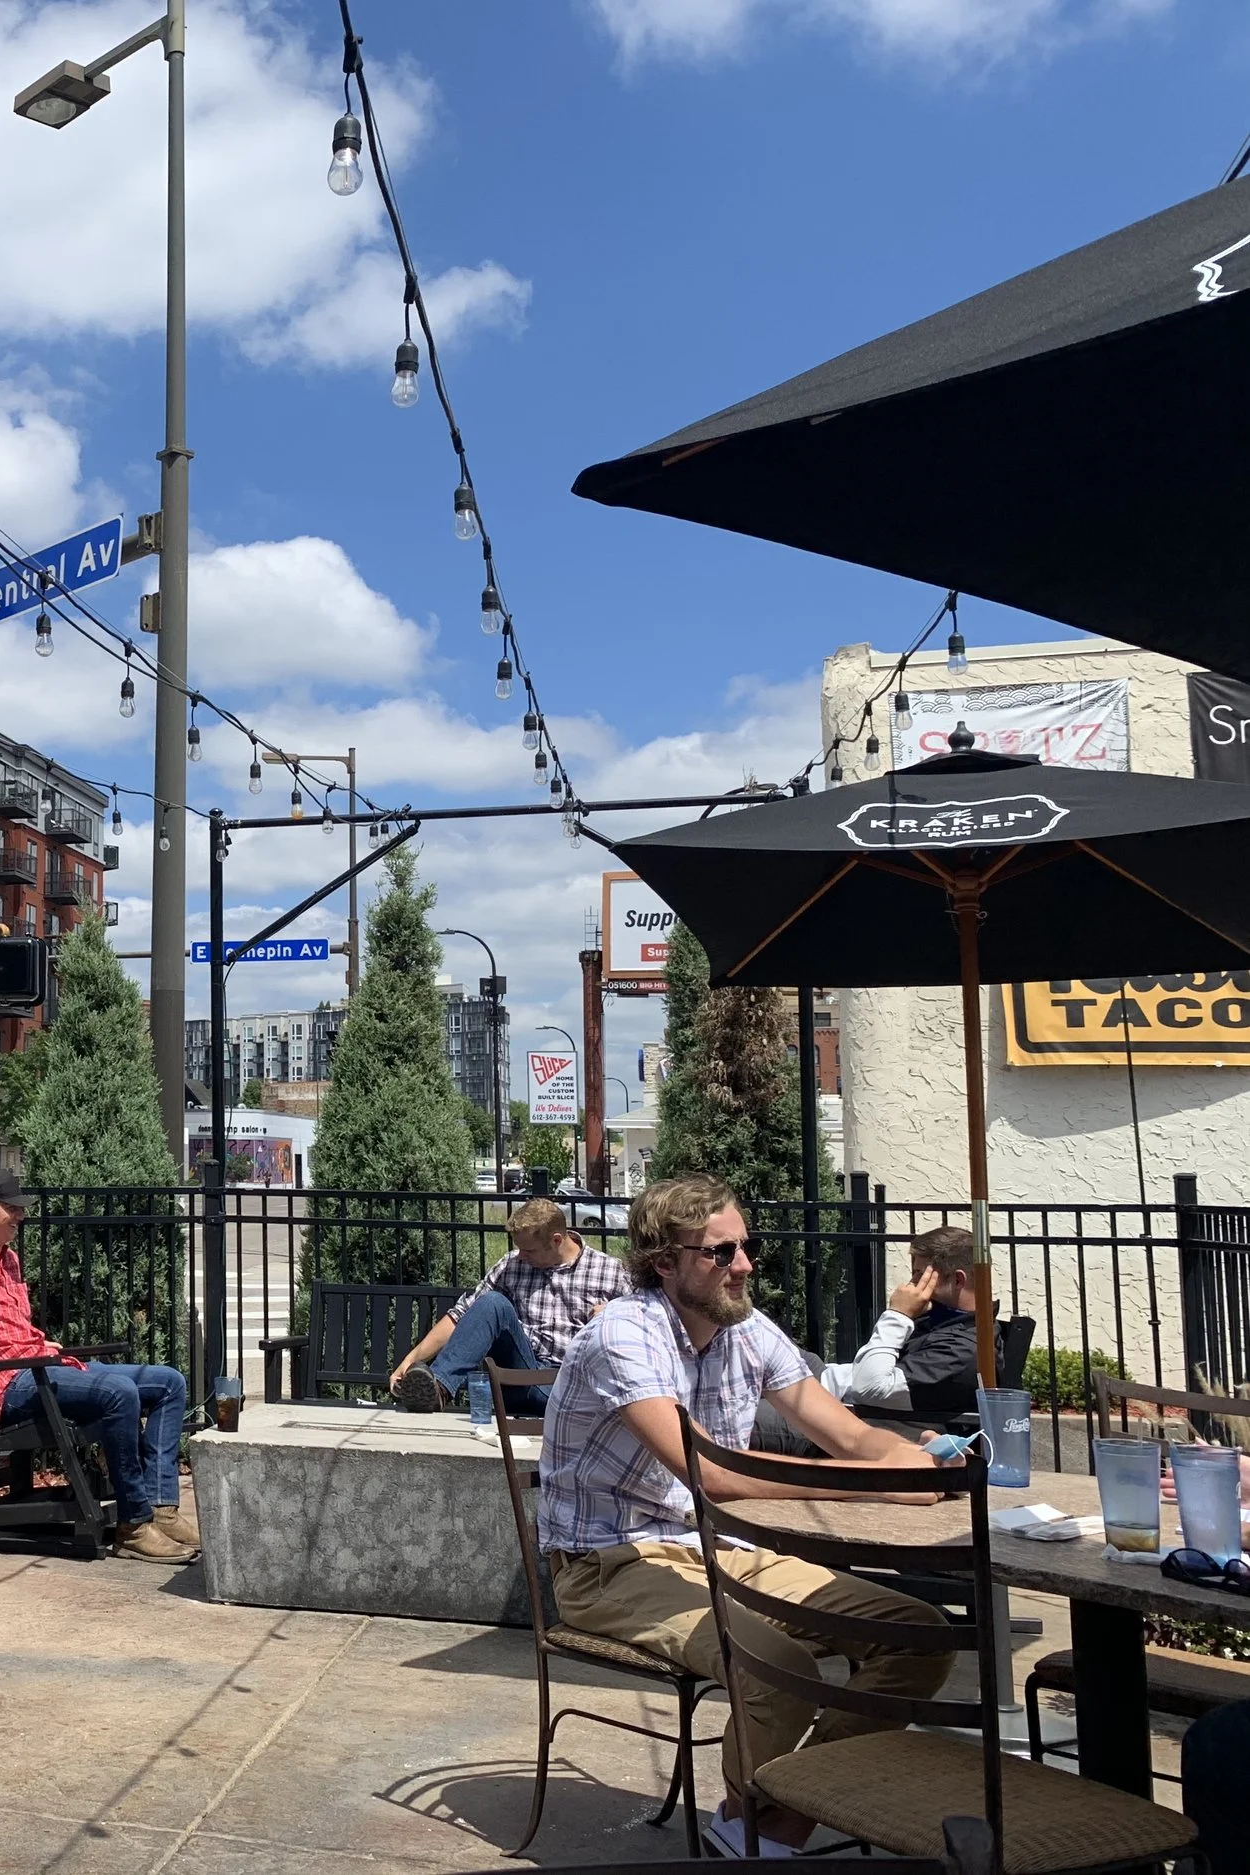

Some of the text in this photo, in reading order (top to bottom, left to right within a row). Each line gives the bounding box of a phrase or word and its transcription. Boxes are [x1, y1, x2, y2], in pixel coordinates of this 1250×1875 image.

[76, 539, 115, 578] Av
[869, 810, 1035, 829] KRAKEN
[952, 822, 1015, 831] SPICED
[927, 830, 972, 838] RUM
[196, 943, 323, 960] E enepin Av
[647, 947, 672, 959] Sup
[1051, 997, 1250, 1029] TACO
